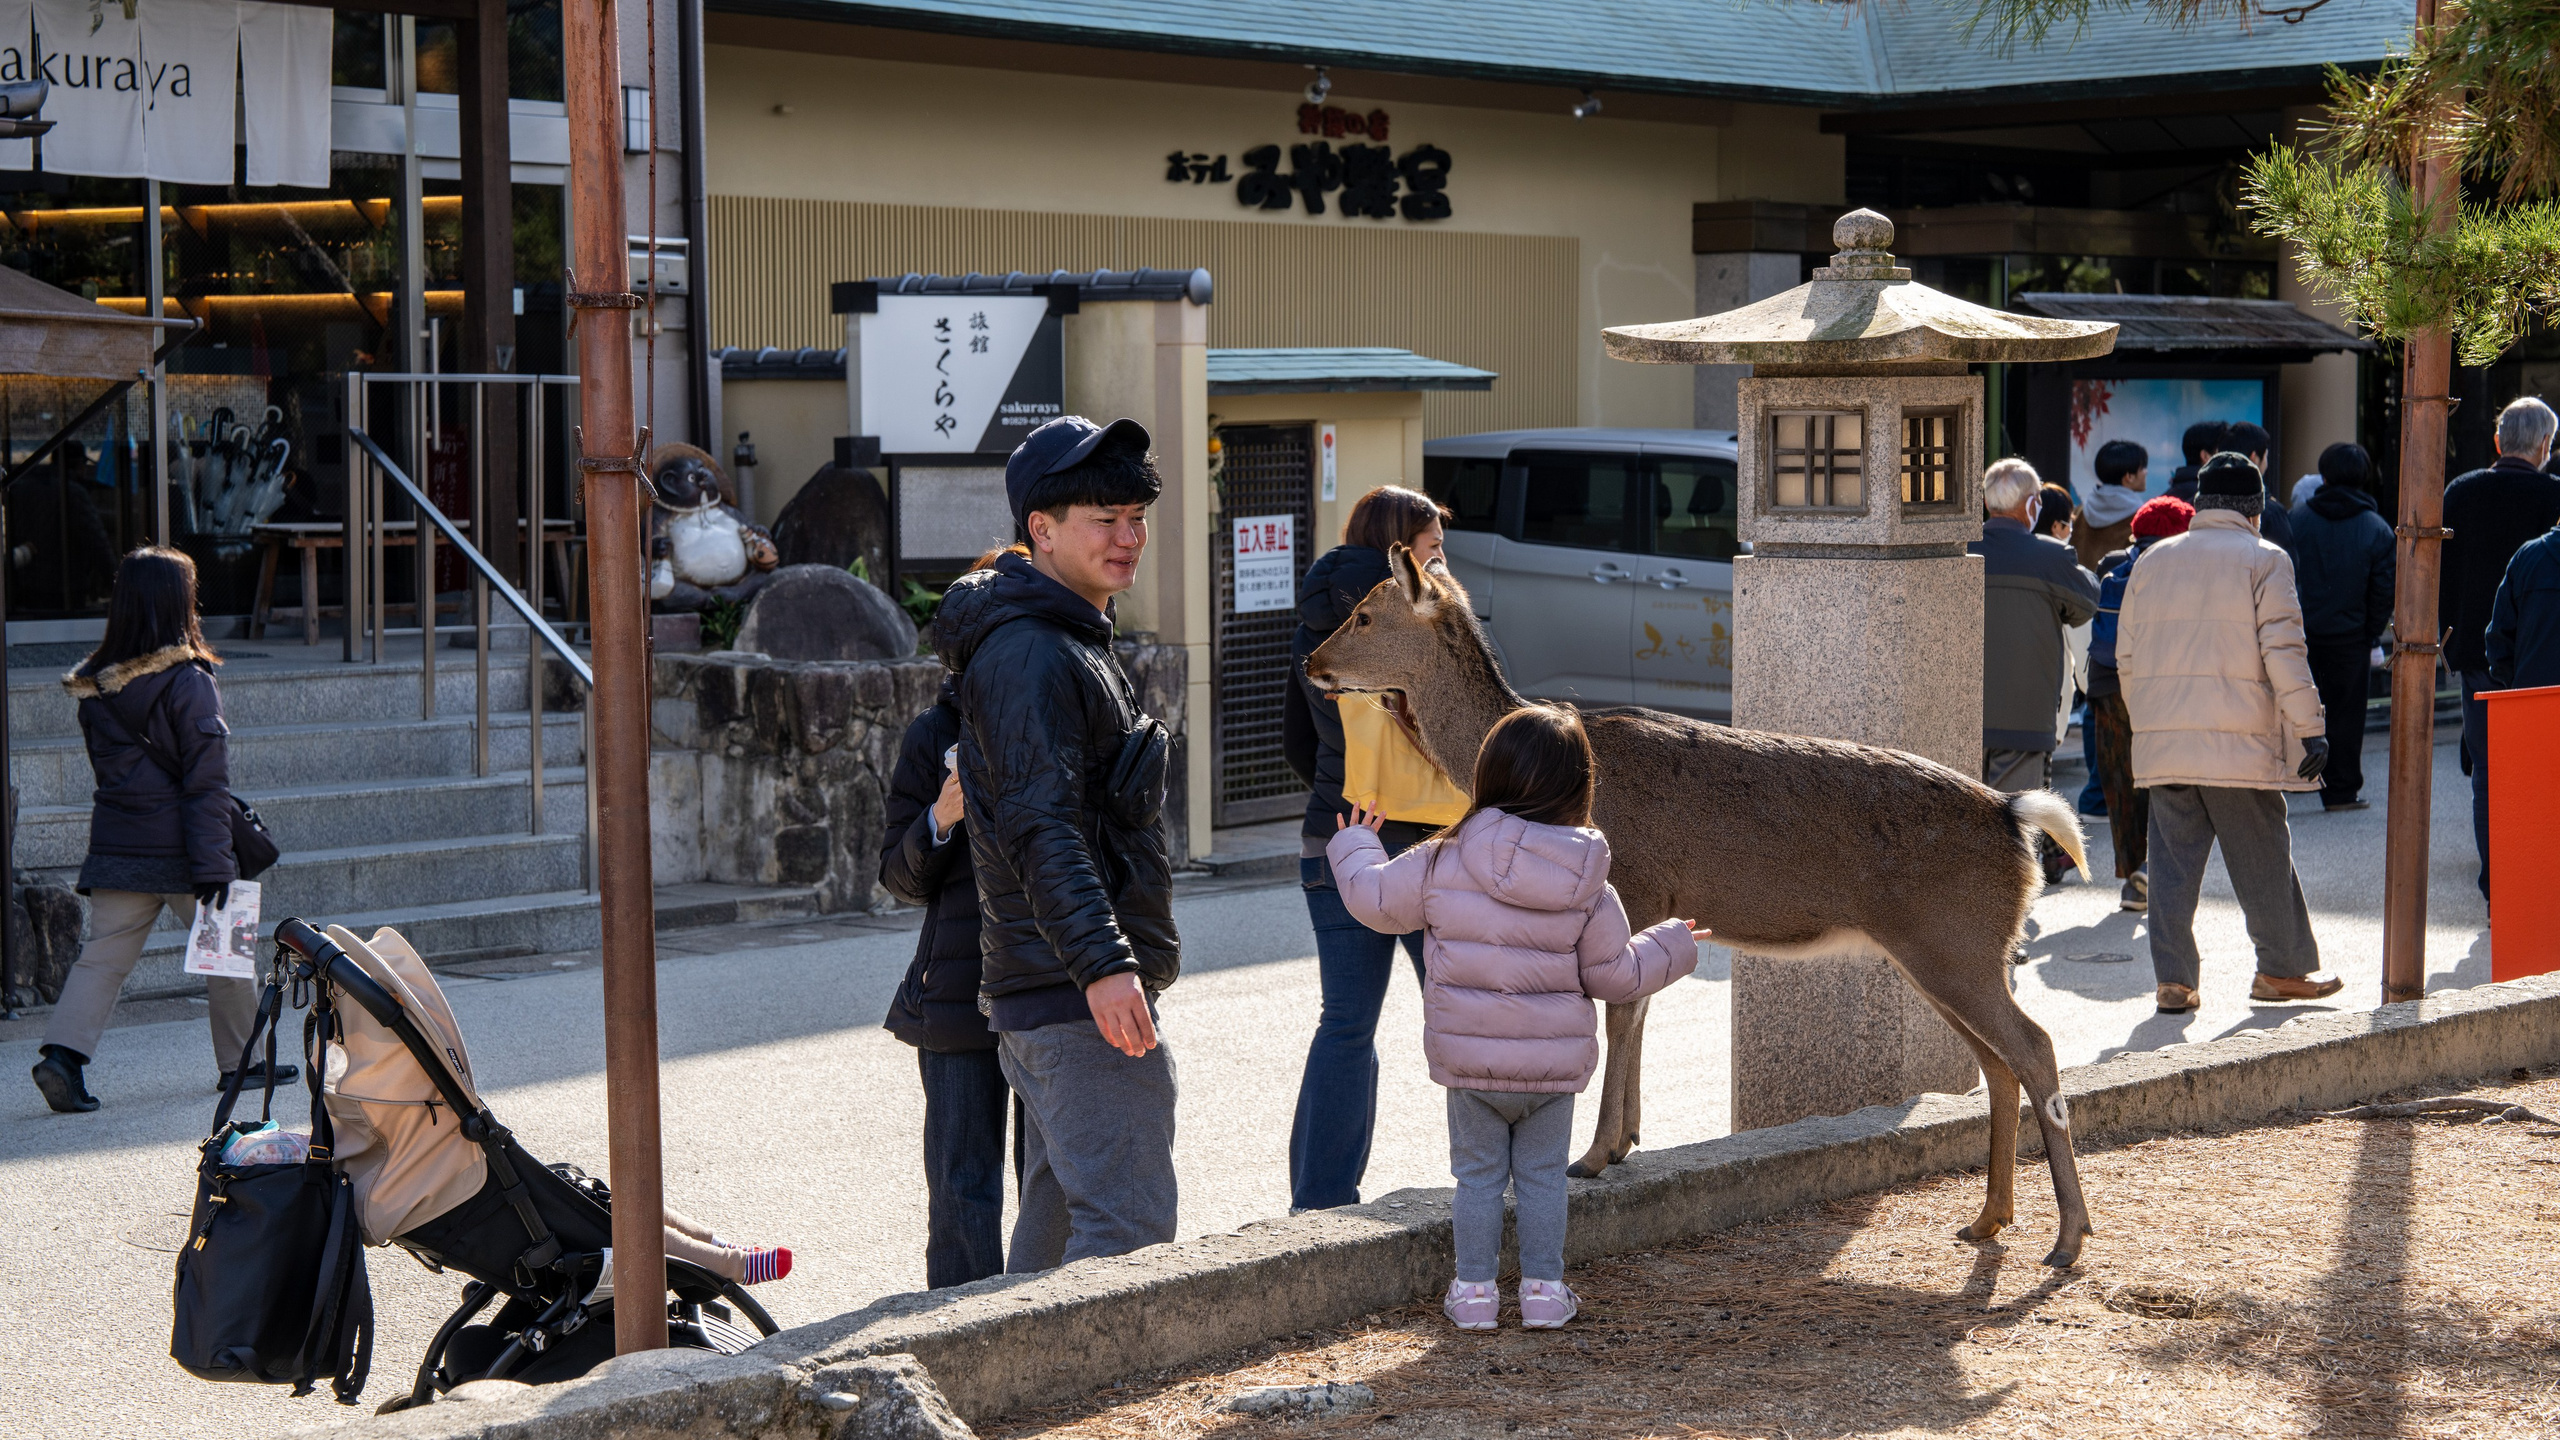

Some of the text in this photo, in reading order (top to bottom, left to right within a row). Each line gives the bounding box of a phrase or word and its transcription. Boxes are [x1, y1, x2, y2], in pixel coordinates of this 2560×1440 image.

[1, 32, 192, 111] akuraya
[1166, 150, 1233, 184] ホテル
[968, 311, 991, 354] 旅館
[933, 317, 957, 439] さくらや
[1000, 401, 1060, 415] sakuraya
[1238, 522, 1290, 554] 立入禁止
